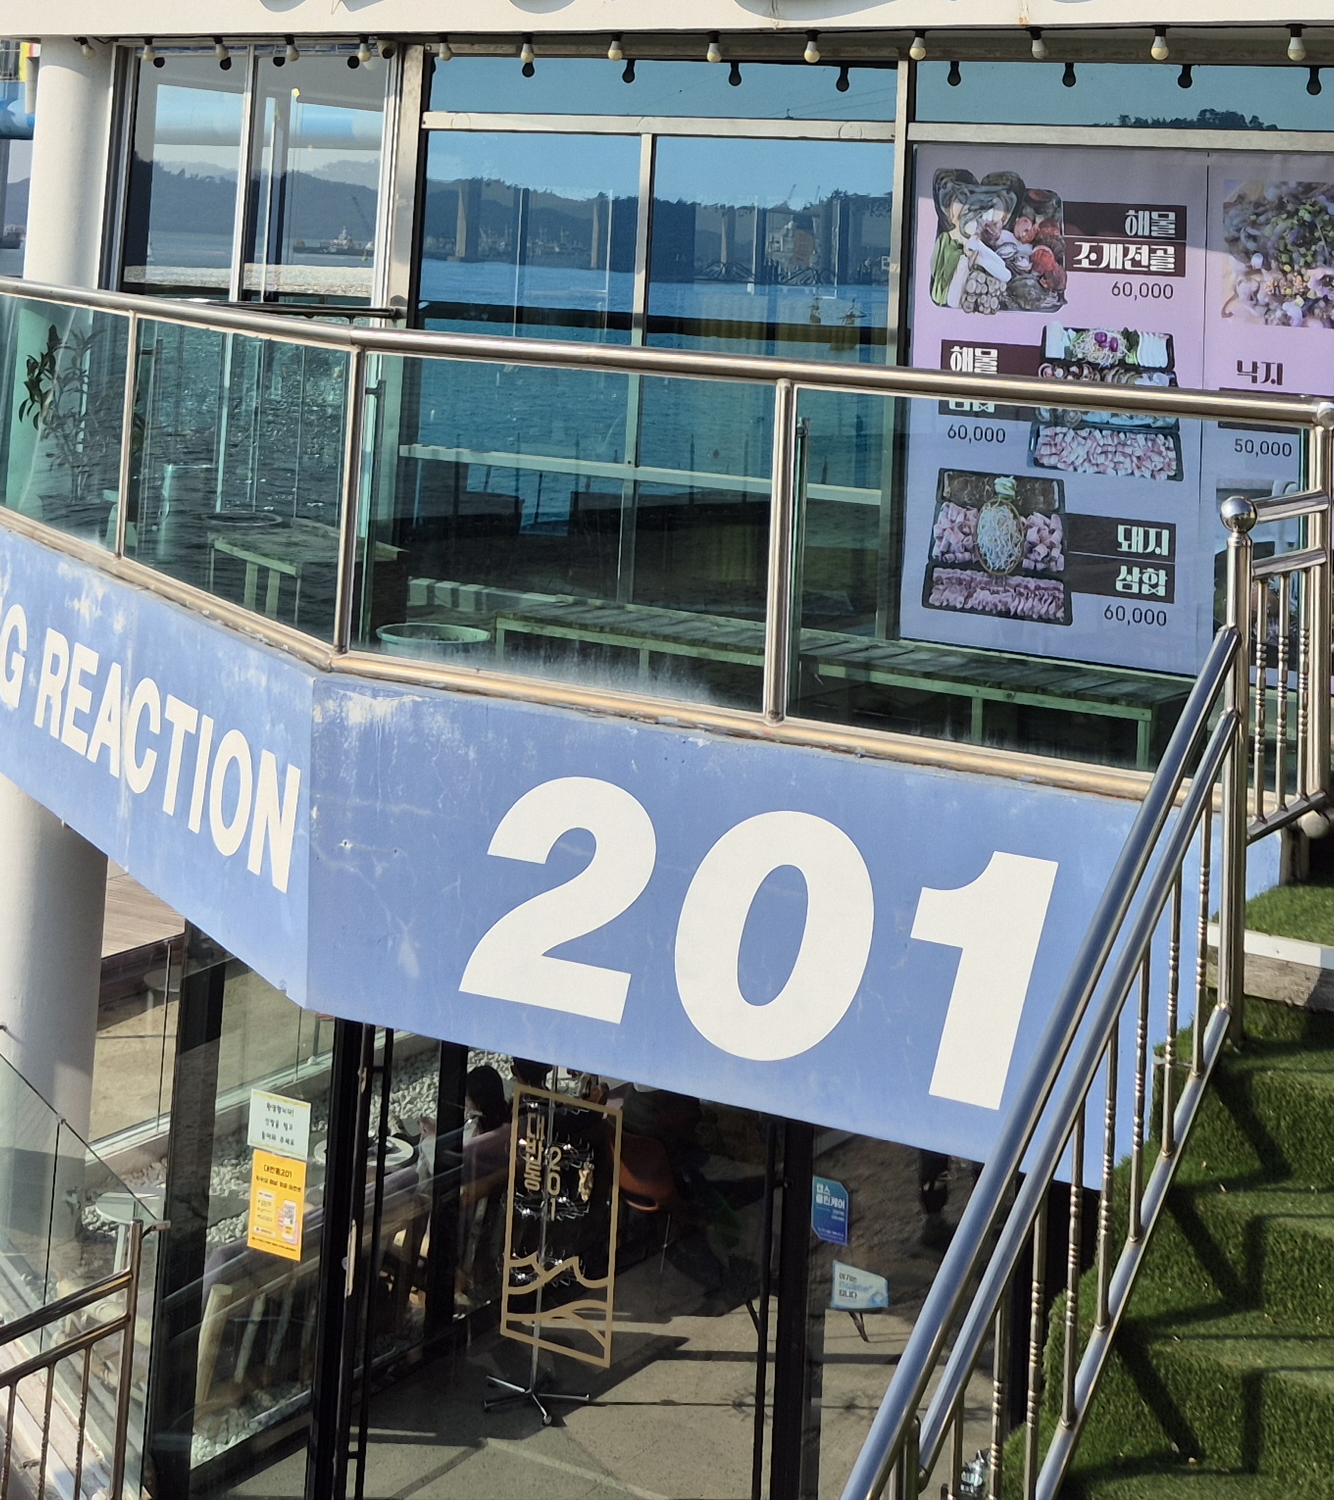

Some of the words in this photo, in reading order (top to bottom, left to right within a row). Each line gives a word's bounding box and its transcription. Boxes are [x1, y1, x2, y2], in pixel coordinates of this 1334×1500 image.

[1124, 208, 1176, 238] 해물
[1073, 240, 1176, 273] 조개전골
[1111, 280, 1174, 301] 60,000
[950, 346, 998, 375] 해물
[1236, 359, 1284, 387] 낙지
[947, 423, 1006, 444] 60,000
[1234, 438, 1293, 458] 50,000
[1116, 523, 1171, 557] 돼지
[1115, 565, 1168, 598] 삼합
[1103, 604, 1168, 628] 60,000
[34, 627, 302, 894] REACTION
[458, 775, 1060, 1112] 201
